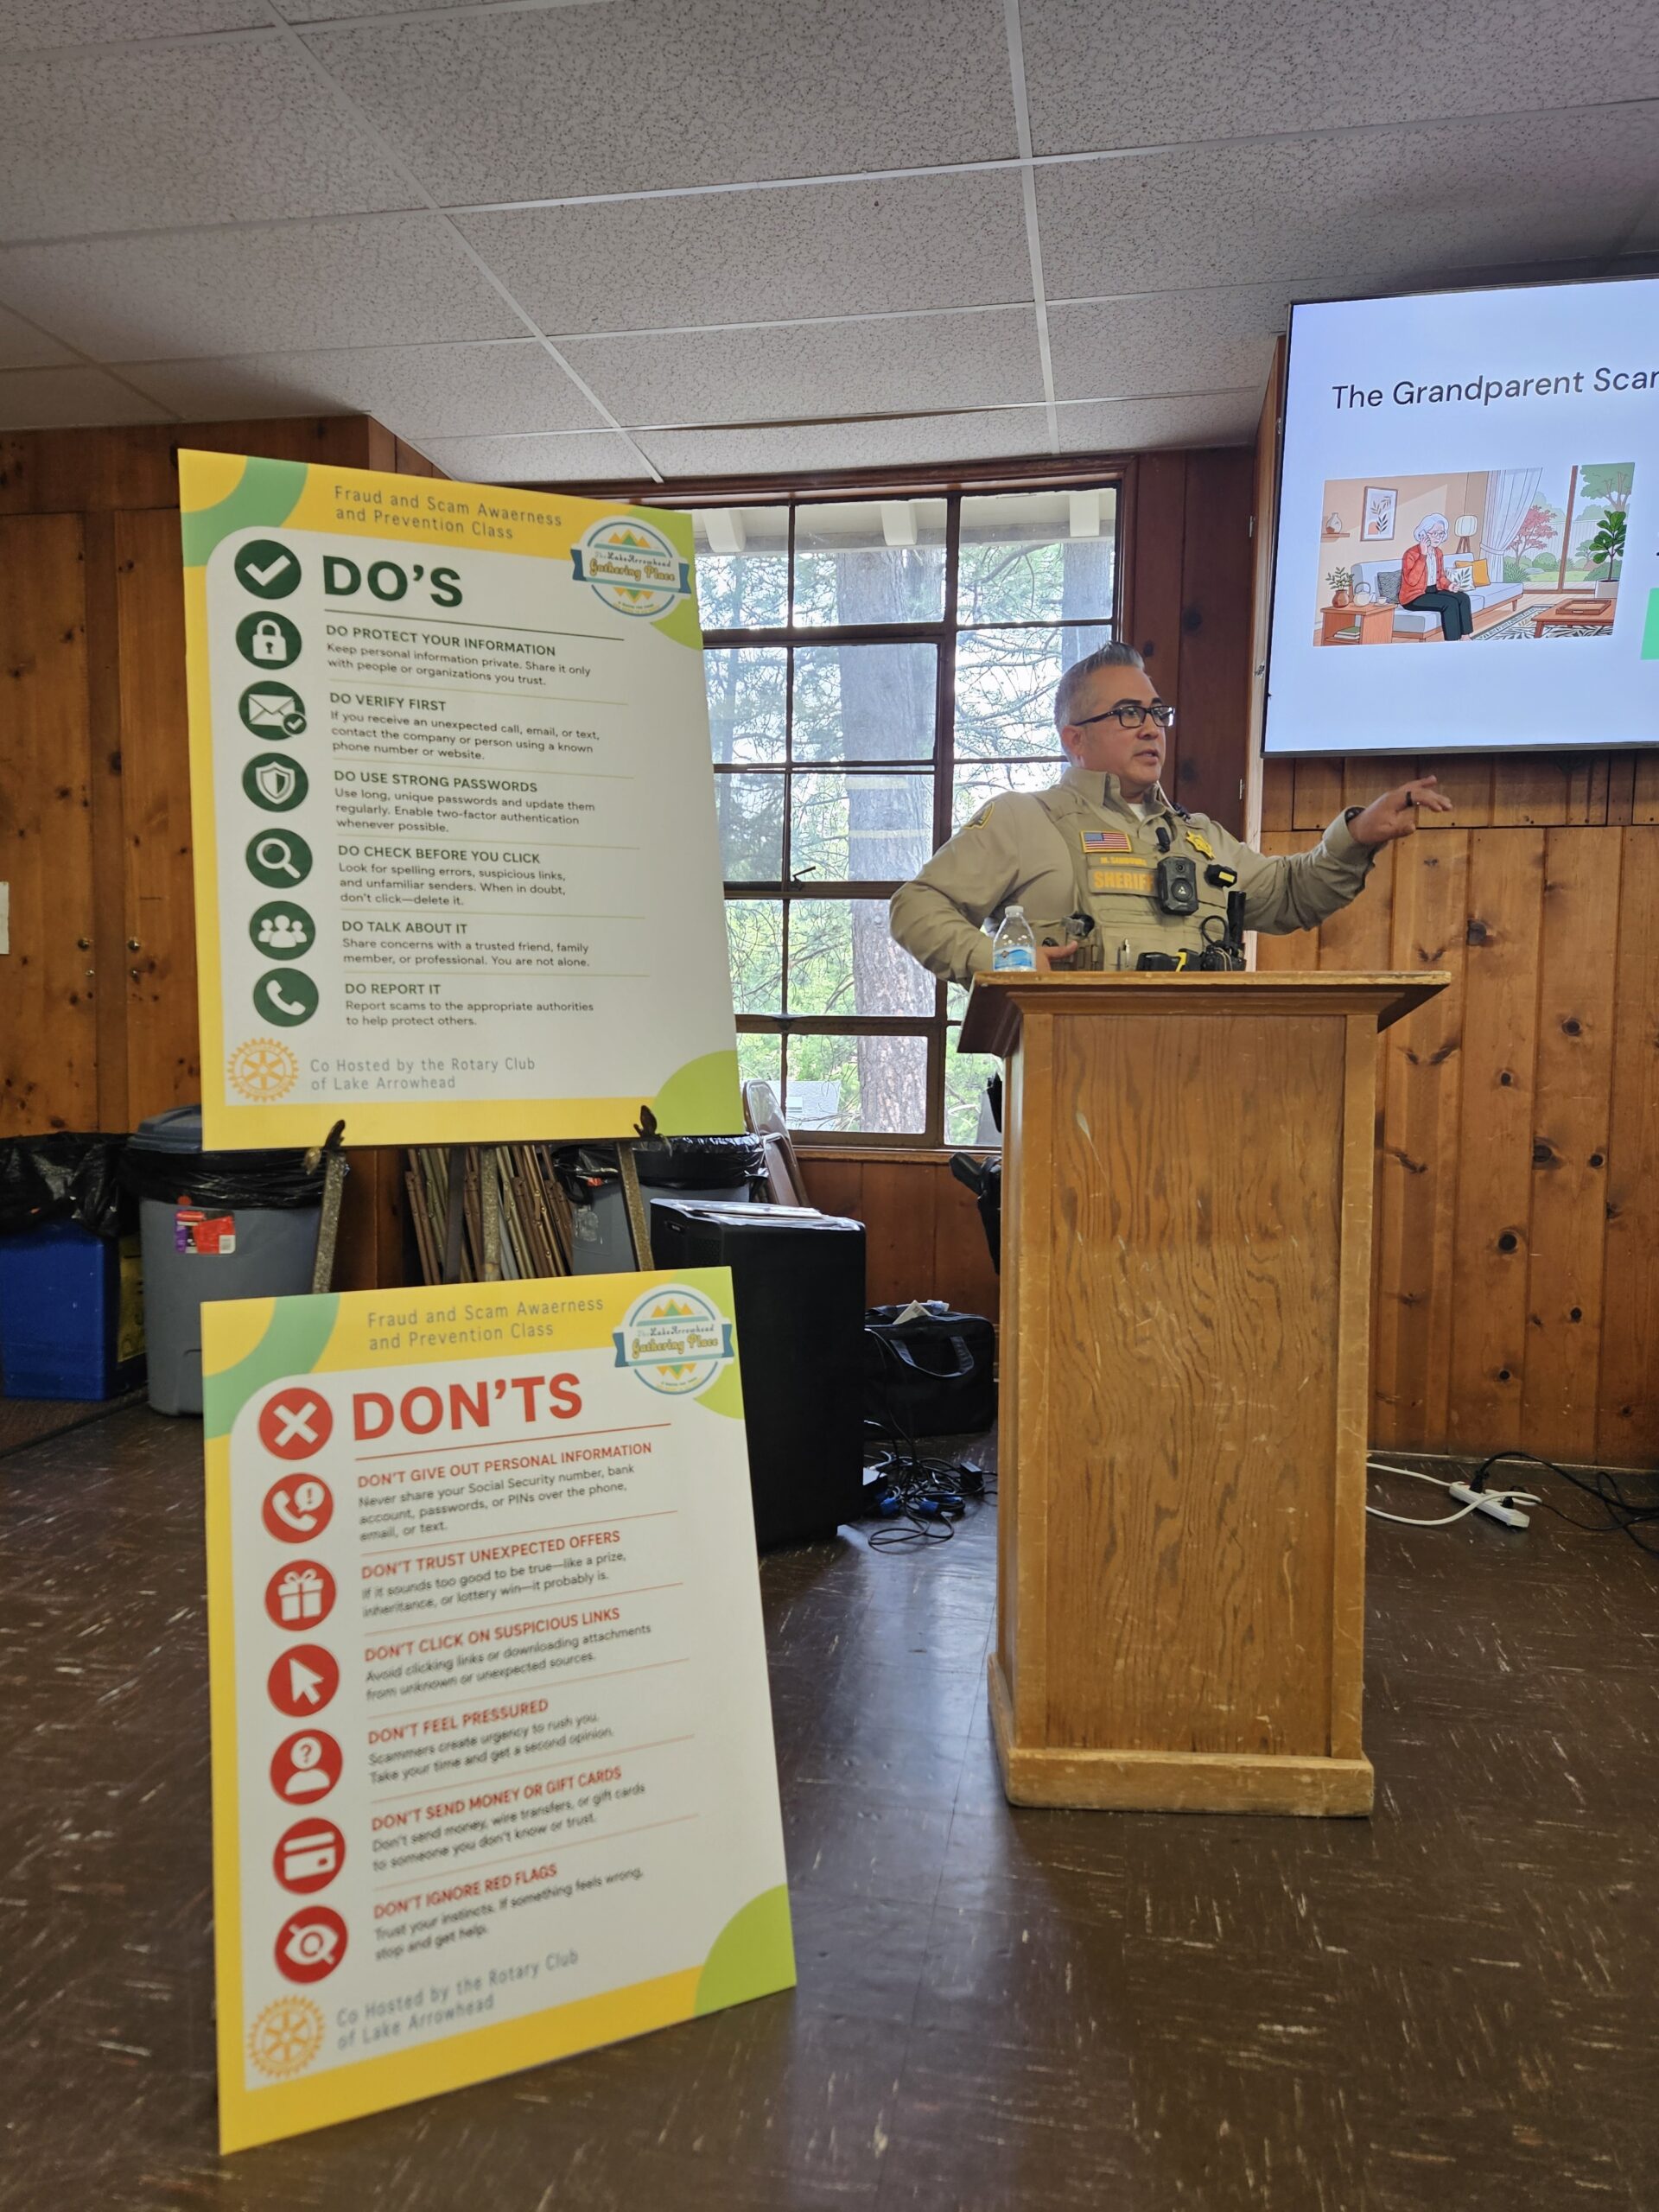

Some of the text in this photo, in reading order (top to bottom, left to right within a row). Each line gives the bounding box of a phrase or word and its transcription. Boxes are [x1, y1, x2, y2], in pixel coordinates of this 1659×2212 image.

[1332, 385, 1383, 410] The
[1393, 371, 1584, 406] Grandparent
[334, 485, 563, 527] Fraud and Scam Awaerness
[335, 507, 513, 540] and Prevention Class
[322, 555, 463, 608] DO'S
[589, 558, 642, 582] Gathering
[326, 624, 556, 657] DO PROTECT YOUR INFORMATION
[329, 692, 447, 712] DO VERIFY FIRST
[334, 770, 538, 793] DO USE STRONG PASSWORDS
[334, 787, 595, 811] Use long, unique passwords and update them
[335, 804, 580, 824] regularly. Enable two-factor authentication
[336, 817, 449, 833] whenever possible.
[338, 844, 540, 864] DO CHECK BEFORE YOU CLICK
[341, 920, 467, 934] DO TALK ABOUT IT
[342, 938, 377, 949] Share
[379, 941, 435, 950] concerns
[436, 940, 462, 950] with
[474, 941, 516, 951] trusted
[518, 941, 554, 953] friend,
[556, 942, 589, 955] family
[343, 953, 396, 965] member,
[398, 956, 411, 964] or
[415, 954, 488, 966] professional.
[491, 955, 512, 966] You
[536, 957, 555, 966] not
[556, 957, 589, 967] alone.
[345, 982, 442, 995] DO REPORT IT
[345, 1000, 594, 1014] Report scams to the appropriate authorities
[346, 1015, 477, 1027] to help protect others.
[309, 1057, 536, 1074] Co Hosted by the Rotary Club
[310, 1075, 456, 1091] of Lake Arrowhead
[367, 1299, 604, 1329] Fraud and Scam Awaerness
[369, 1322, 554, 1351] and Prevention Class
[632, 1338, 685, 1359] Gathering
[353, 1372, 582, 1441] DON'TS
[358, 1442, 652, 1489] DON'T GIVE OUT PERSONAL INFORMATION
[361, 1529, 620, 1580] DON'T TRUST UNEXPECTED OFFERS
[365, 1607, 620, 1662] DON'T CLICK ON SUSPICIOUS LINKS
[368, 1699, 549, 1745] DON'T FEEL PRESSURED
[372, 1766, 622, 1832] DON'T SEND MONEY OR GIFT CARDS
[373, 1863, 557, 1920] DON'T IGNORE RED FLAGS
[336, 1948, 579, 2028] Co Hosted by the Rotary Club
[337, 1993, 494, 2051] of Lake Arrowhead
